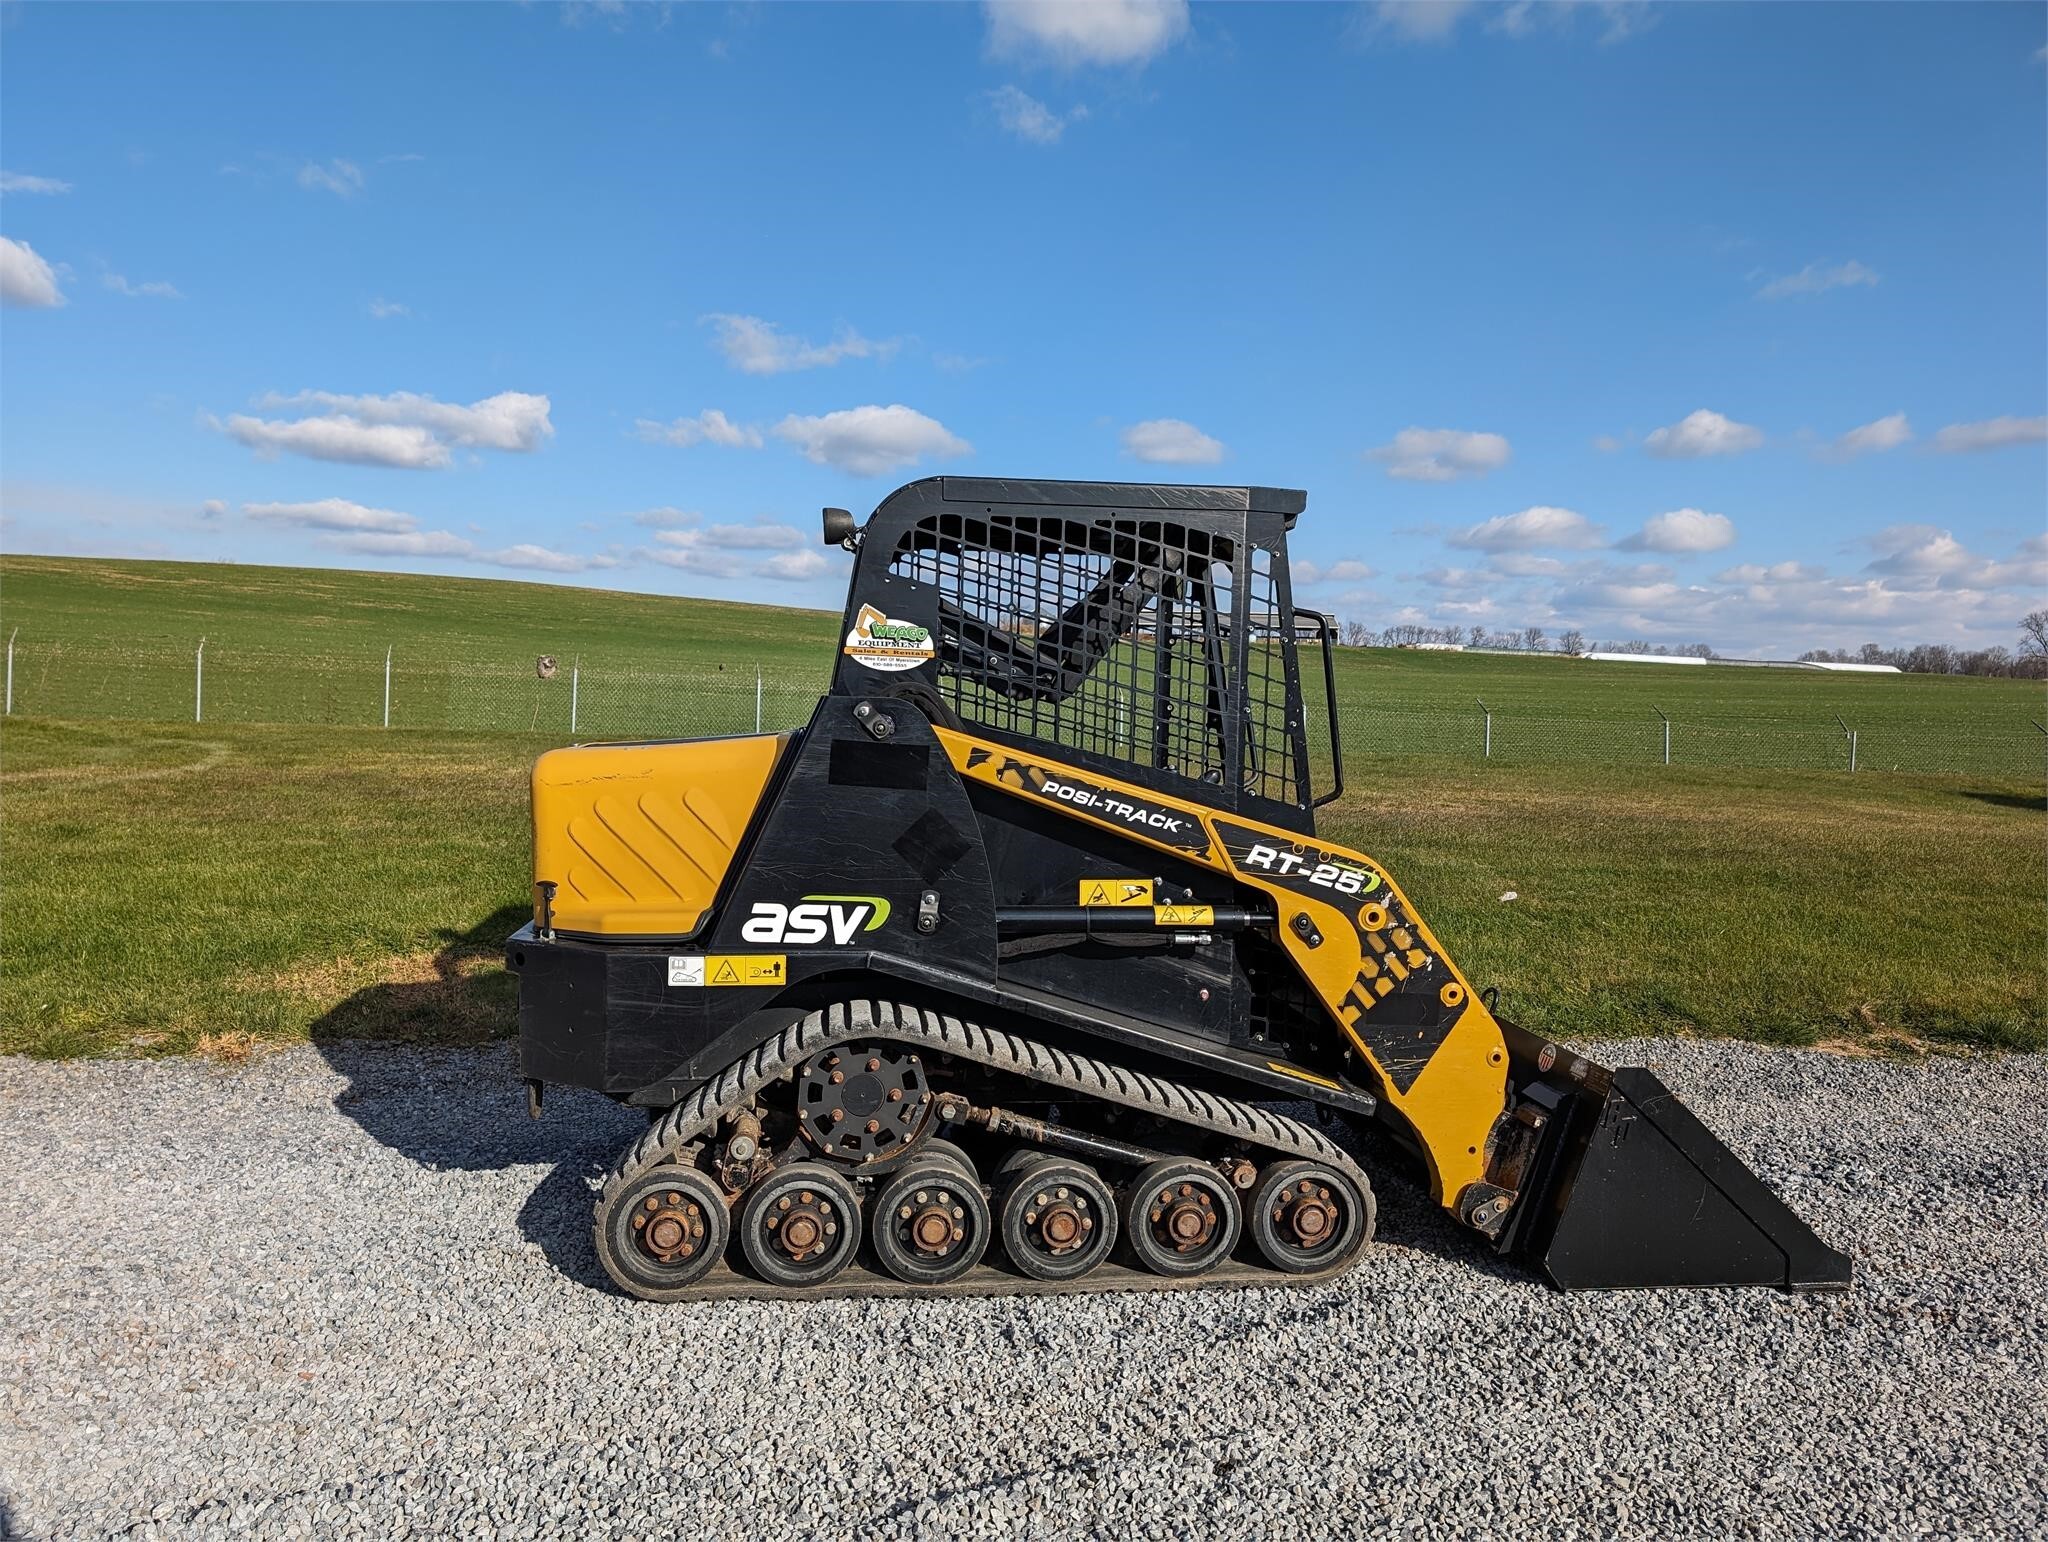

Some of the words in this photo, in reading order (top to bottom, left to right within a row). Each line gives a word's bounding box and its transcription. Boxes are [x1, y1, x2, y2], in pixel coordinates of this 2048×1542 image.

[858, 640, 921, 648] EQUIPMENT
[869, 621, 928, 642] WEACO
[1041, 781, 1183, 833] POSI-TRACK
[1245, 844, 1365, 894] RT-25
